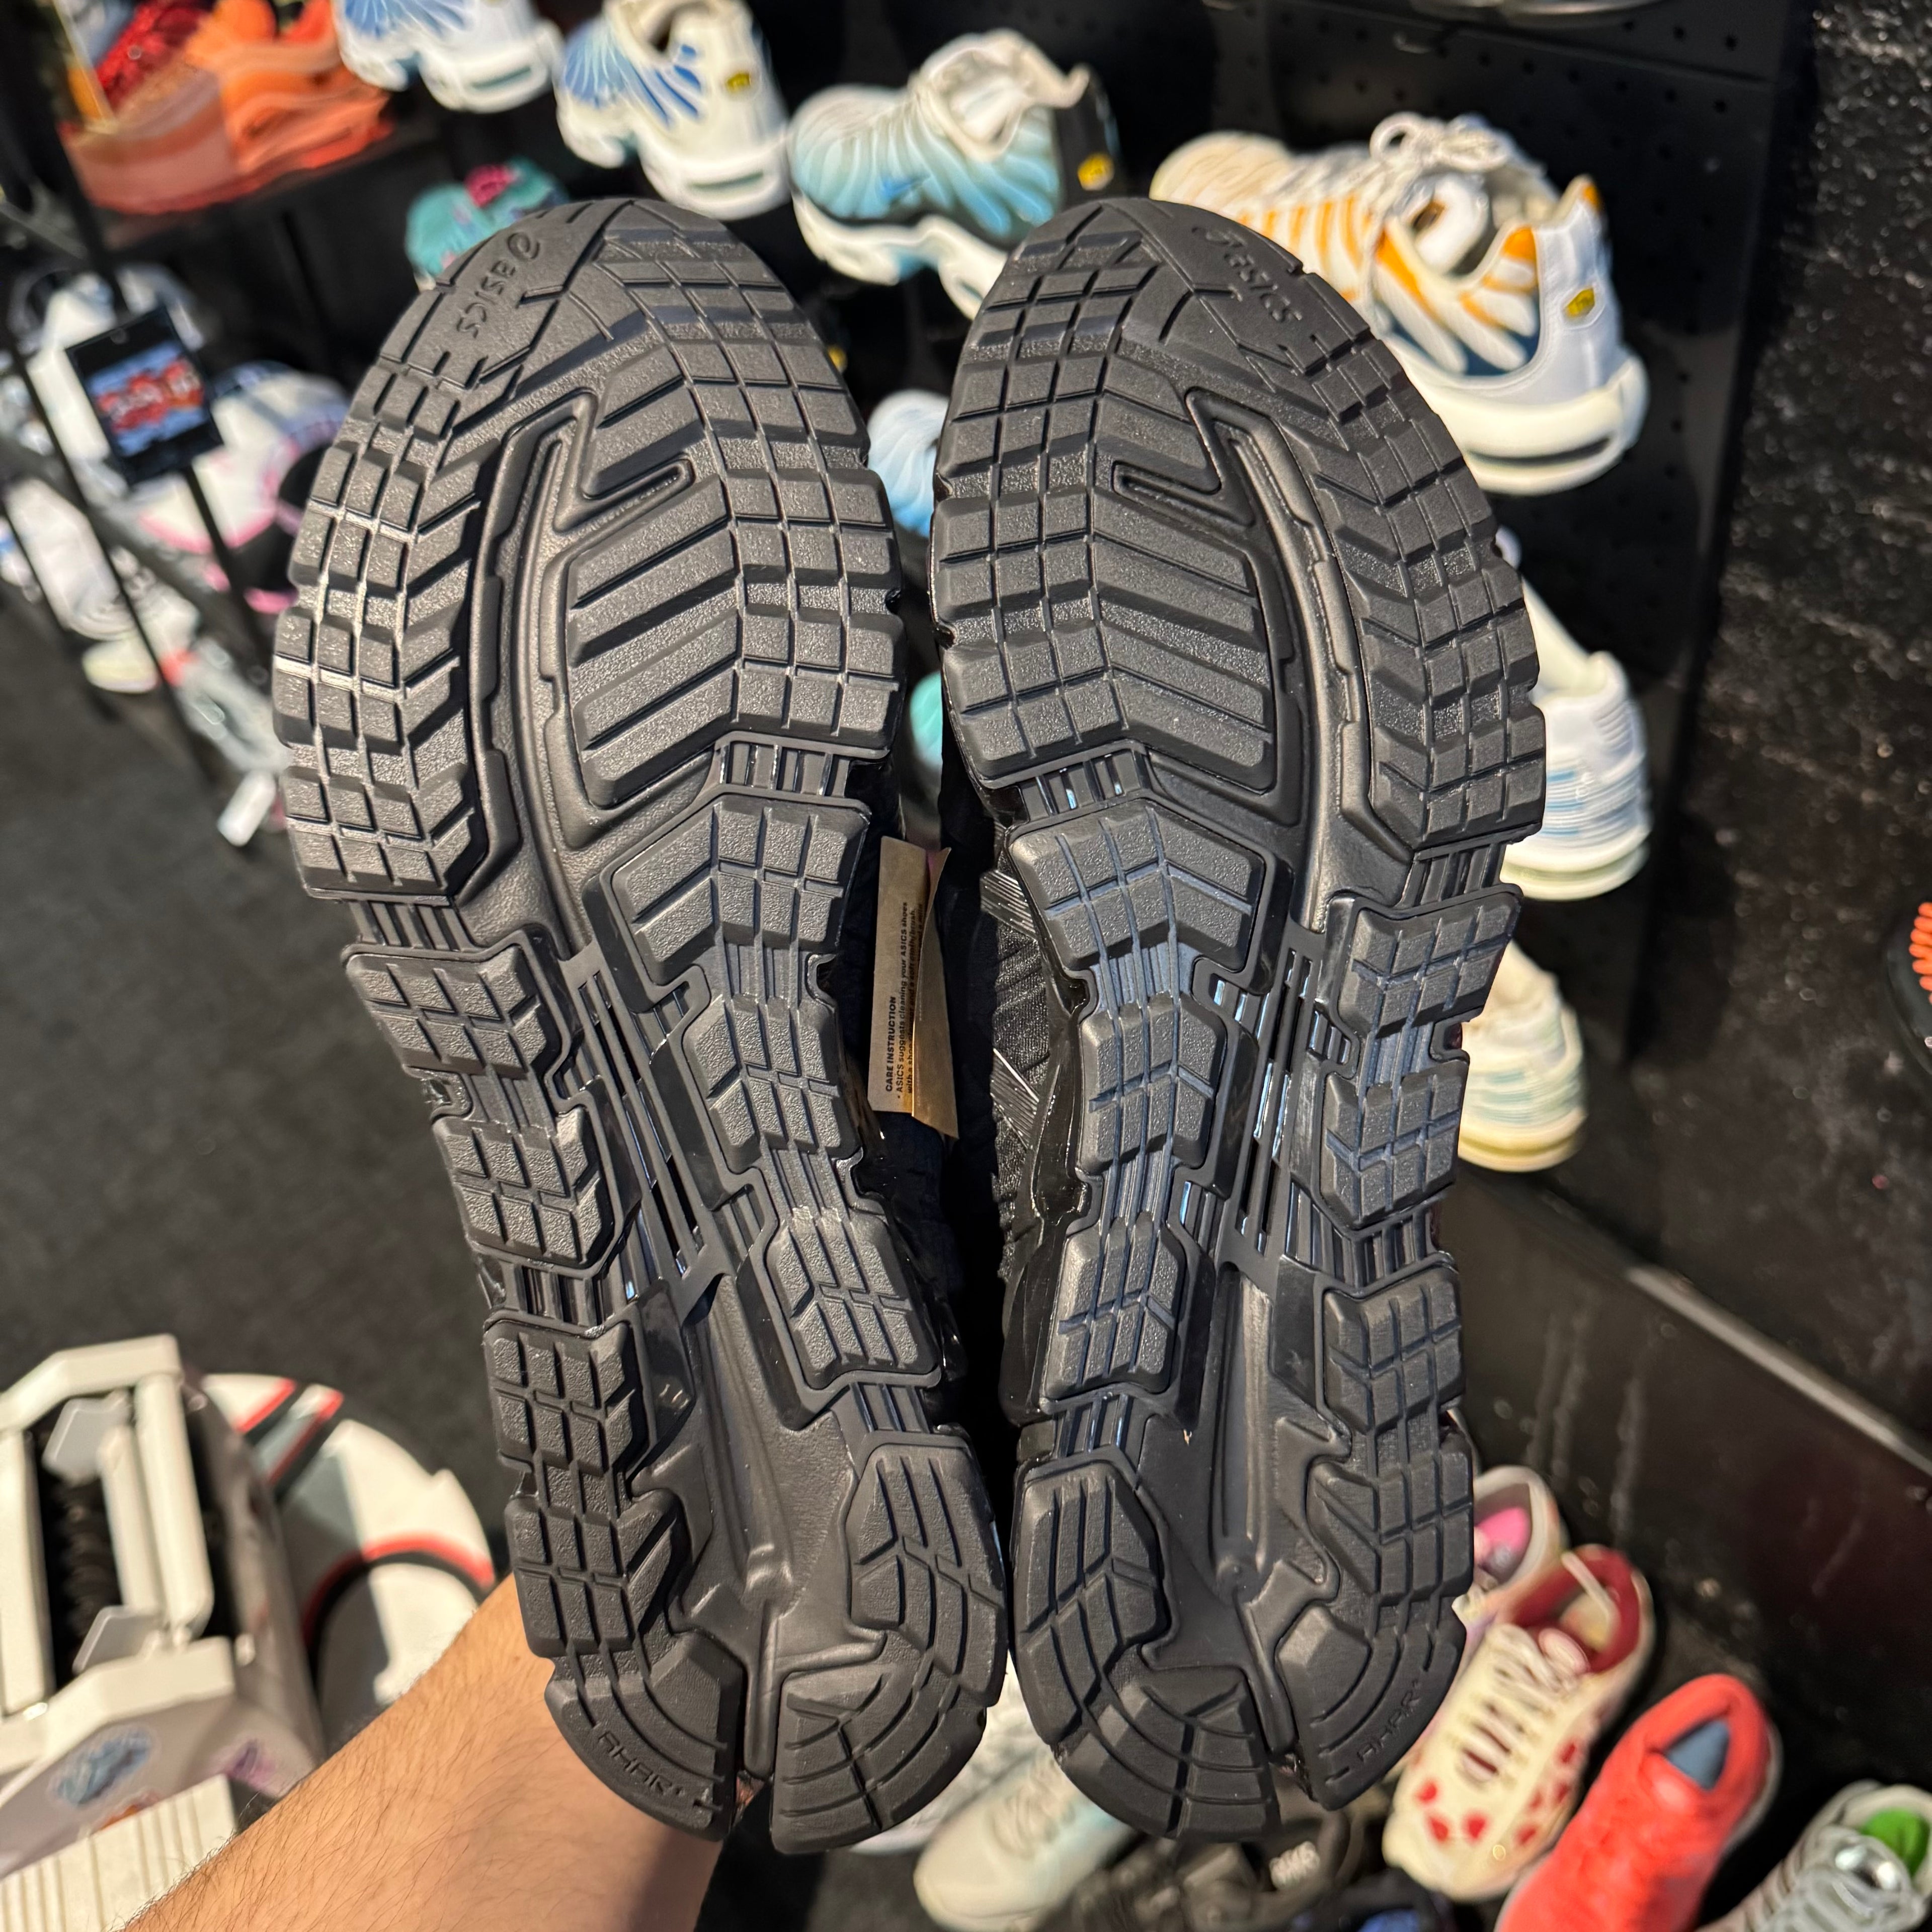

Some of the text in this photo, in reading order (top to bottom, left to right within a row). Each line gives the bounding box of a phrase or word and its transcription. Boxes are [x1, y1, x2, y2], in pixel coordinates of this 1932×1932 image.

[899, 981, 907, 1019] cleaning
[886, 997, 896, 1092] CARE INSTRUCTION
